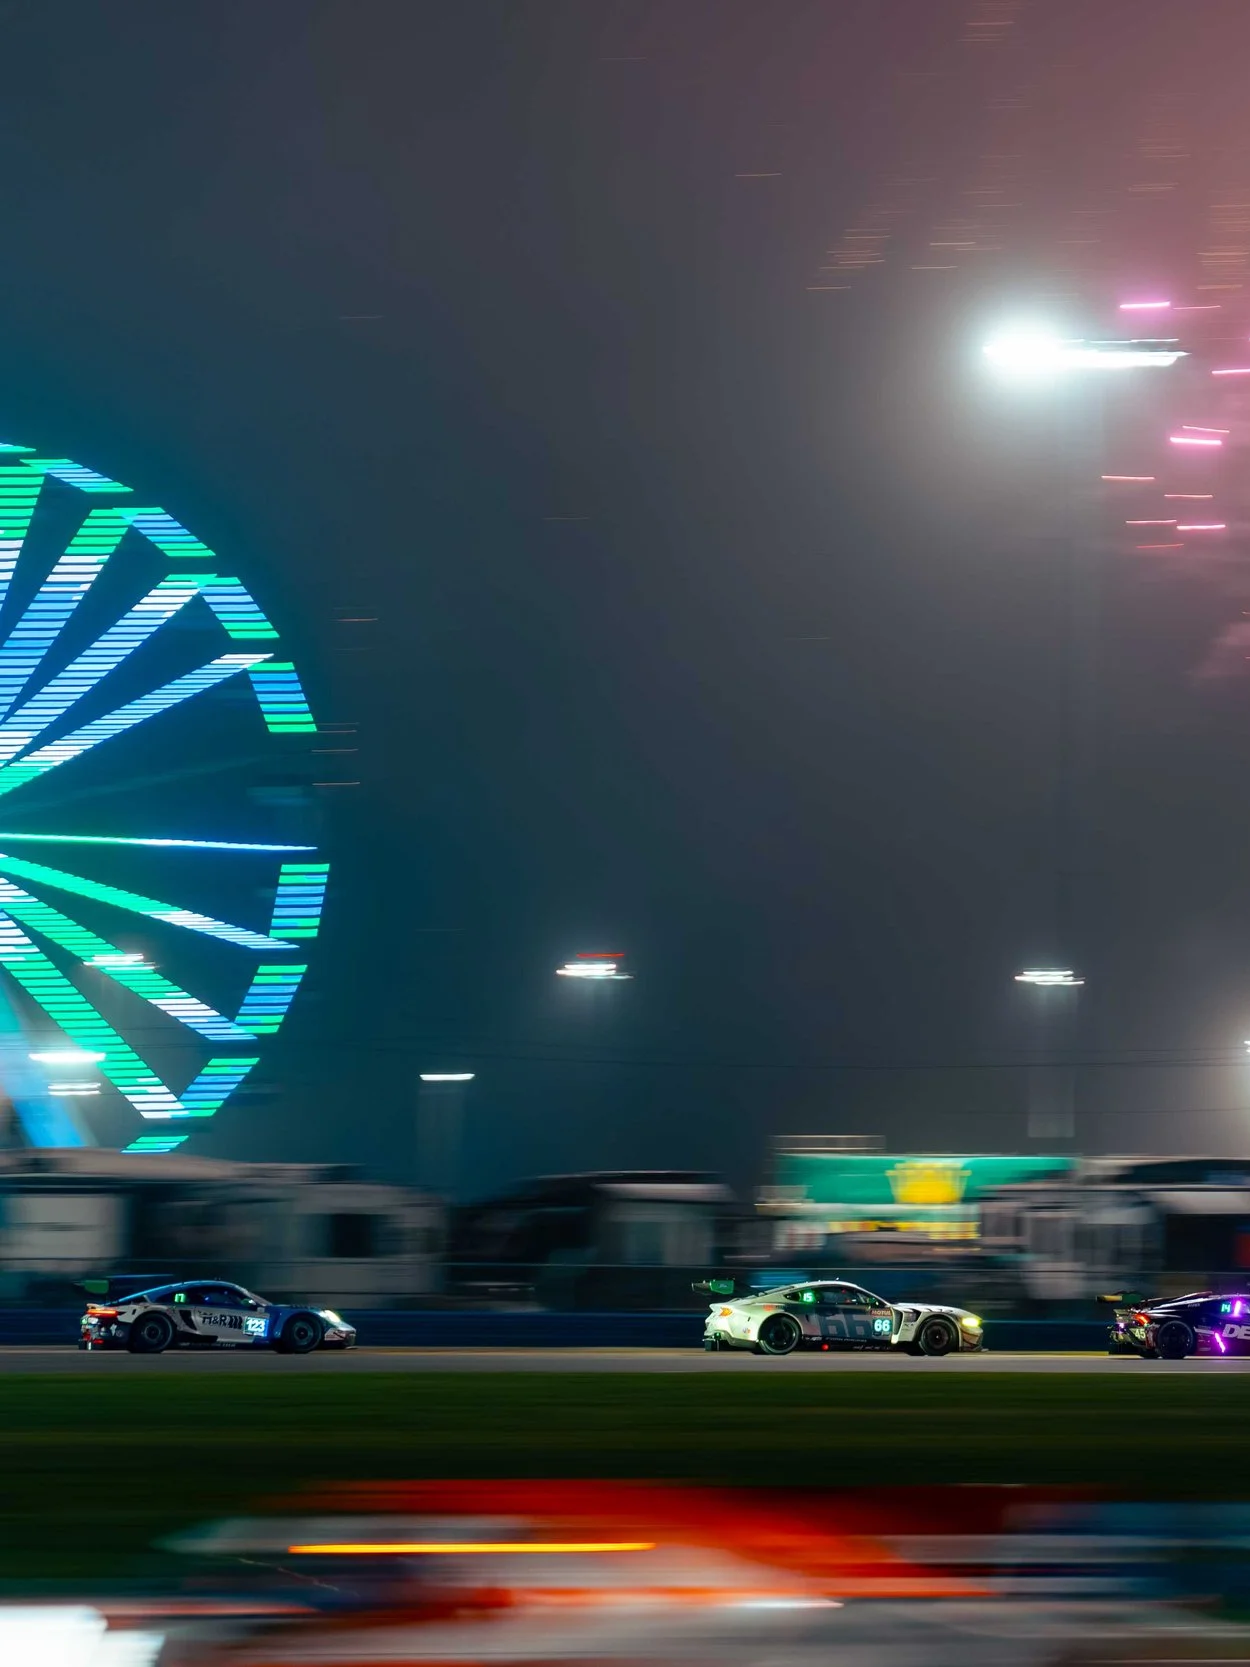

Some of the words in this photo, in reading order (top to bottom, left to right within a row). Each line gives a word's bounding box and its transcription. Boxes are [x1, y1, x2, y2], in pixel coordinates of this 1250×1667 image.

[803, 1293, 813, 1302] 15
[1221, 1303, 1231, 1313] 14
[202, 1312, 227, 1327] H&R
[874, 1319, 891, 1332] 66
[246, 1319, 266, 1333] 123
[1134, 1328, 1146, 1339] 45
